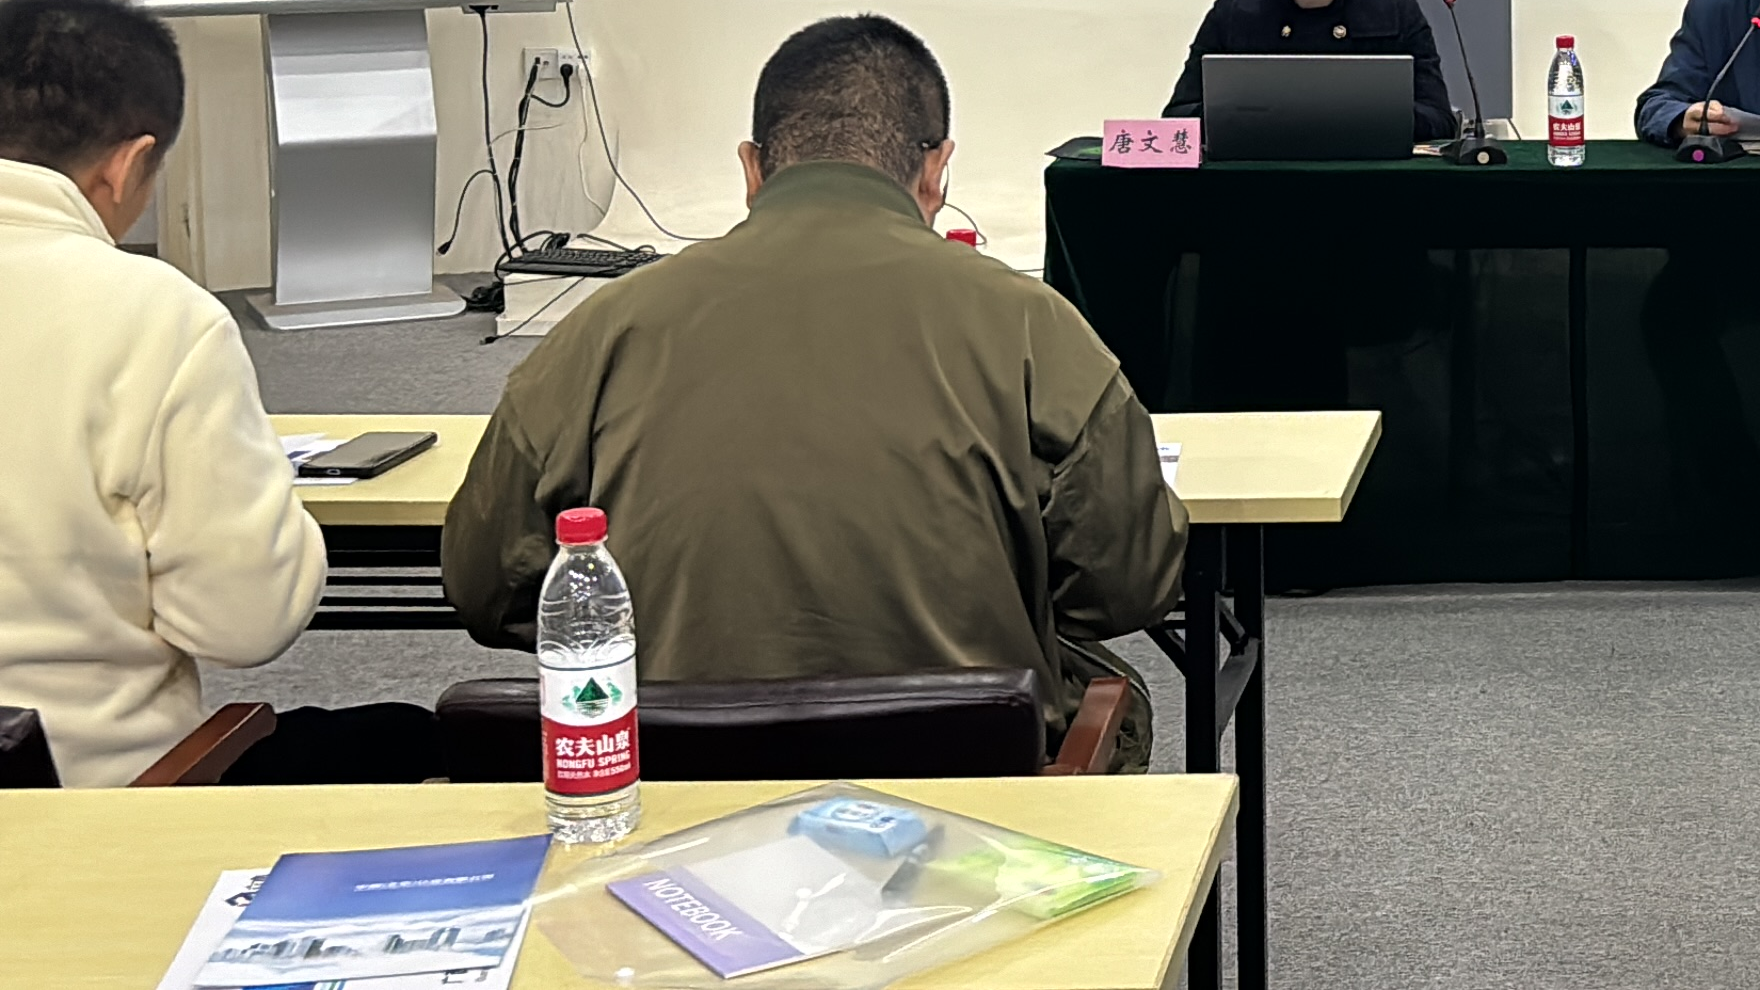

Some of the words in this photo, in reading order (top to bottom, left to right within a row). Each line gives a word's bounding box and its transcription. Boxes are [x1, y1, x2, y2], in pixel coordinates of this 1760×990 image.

[1108, 129, 1193, 156] 唐文慧
[555, 730, 630, 758] 农夫山泉
[556, 758, 596, 769] NONGFU
[598, 749, 631, 767] SPRING
[642, 877, 746, 942] NOTEBOOK
